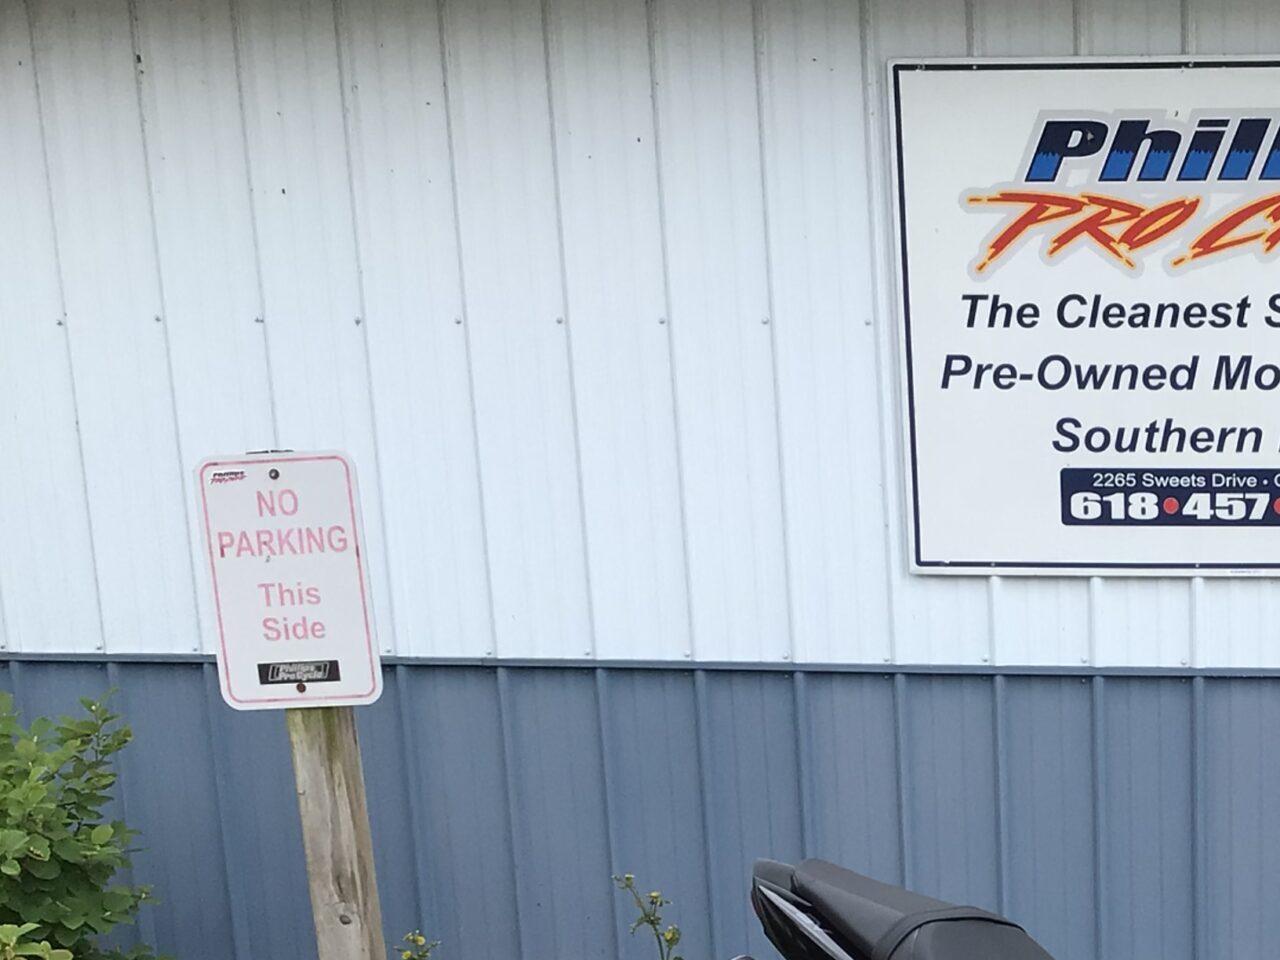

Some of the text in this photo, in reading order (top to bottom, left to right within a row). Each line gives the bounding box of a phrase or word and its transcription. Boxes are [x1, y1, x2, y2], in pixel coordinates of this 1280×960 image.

[968, 191, 1202, 273] PRO
[960, 294, 1040, 329] The
[1056, 294, 1251, 329] Cleanest
[941, 354, 1199, 391] Pre-Owned
[1052, 418, 1263, 454] Southern
[1093, 473, 1136, 487] 2265
[1142, 473, 1206, 487] Sweets
[1212, 473, 1257, 487] Drive
[256, 489, 299, 518] NO
[217, 525, 349, 558] PARKING
[257, 582, 322, 607] This
[262, 616, 326, 642] Side
